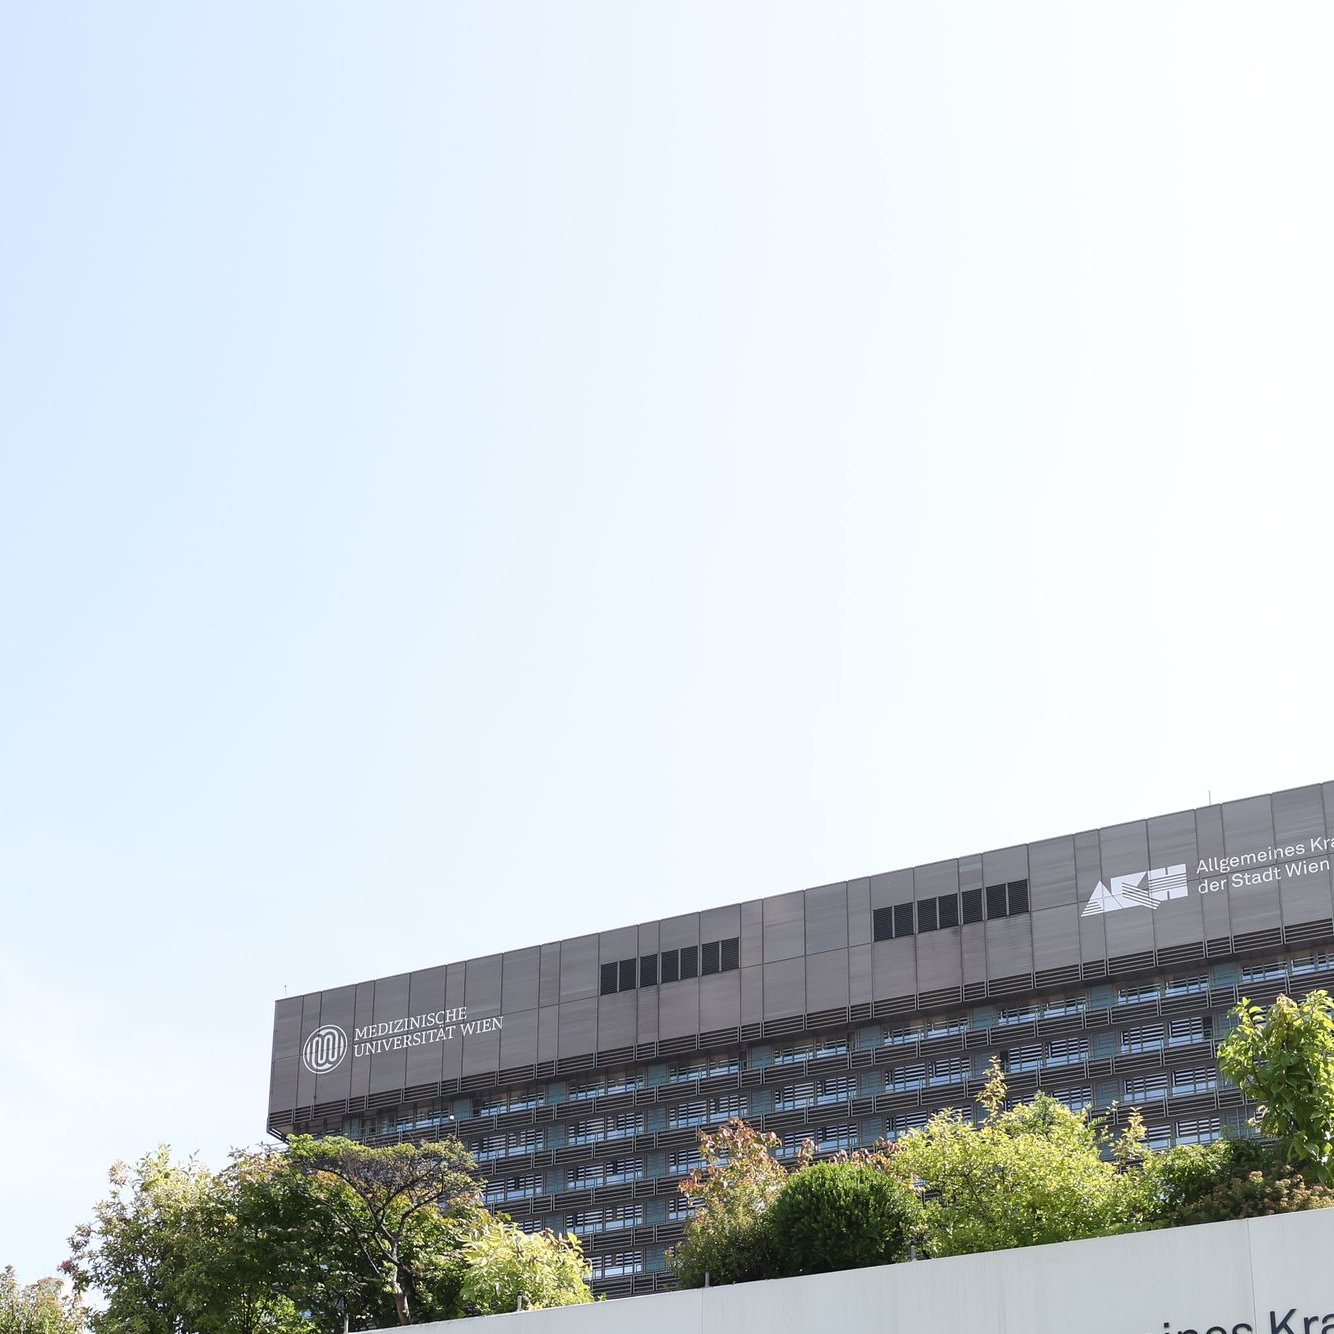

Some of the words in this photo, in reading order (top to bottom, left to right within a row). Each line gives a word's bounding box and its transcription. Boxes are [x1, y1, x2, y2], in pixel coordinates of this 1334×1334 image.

[1196, 841, 1305, 875] Allgemeines
[1197, 876, 1228, 896] der
[1231, 868, 1282, 889] Stadt
[1285, 858, 1331, 880] Wien
[353, 1024, 456, 1058] UNIVERSITÄT
[461, 1016, 504, 1037] WIEN
[354, 1006, 467, 1041] MEDIZINISCHE
